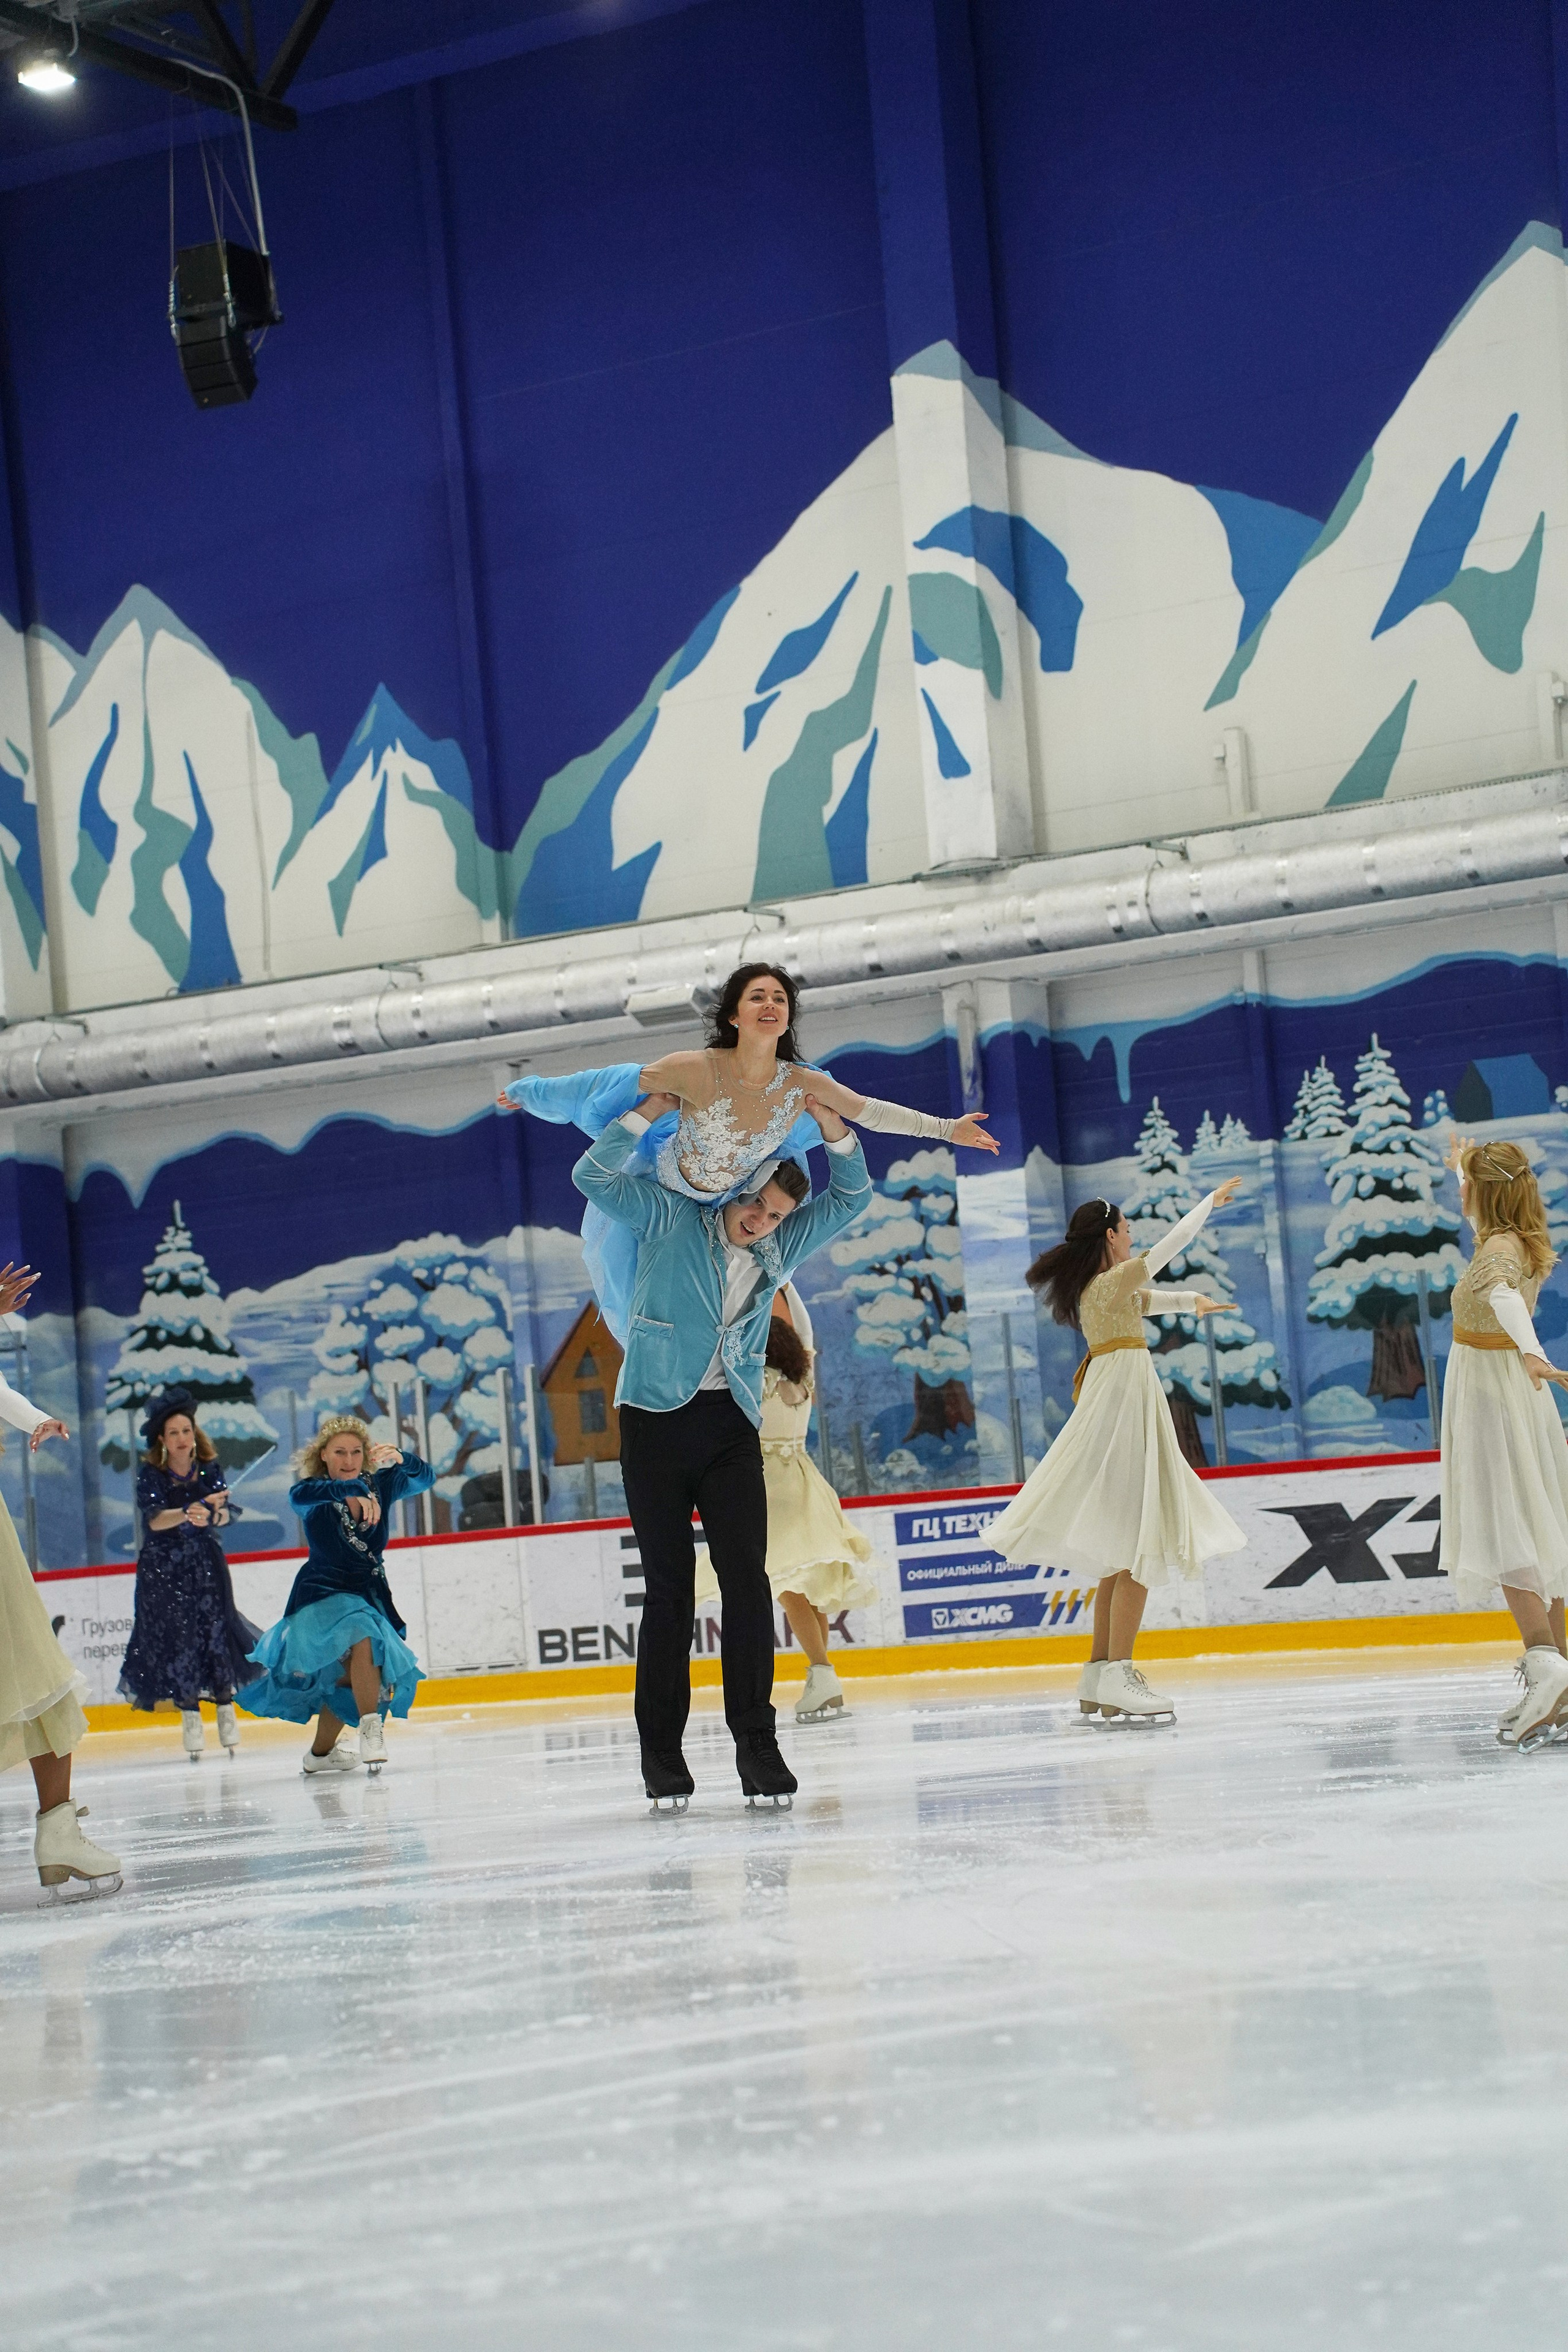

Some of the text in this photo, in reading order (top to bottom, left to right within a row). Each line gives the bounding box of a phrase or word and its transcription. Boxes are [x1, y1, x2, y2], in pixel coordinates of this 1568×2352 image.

[943, 1510, 1005, 1534] ТЕХН
[907, 1560, 992, 1581] ОФИЦИАЛЬНЫЙ
[950, 1603, 1014, 1628] XCMG
